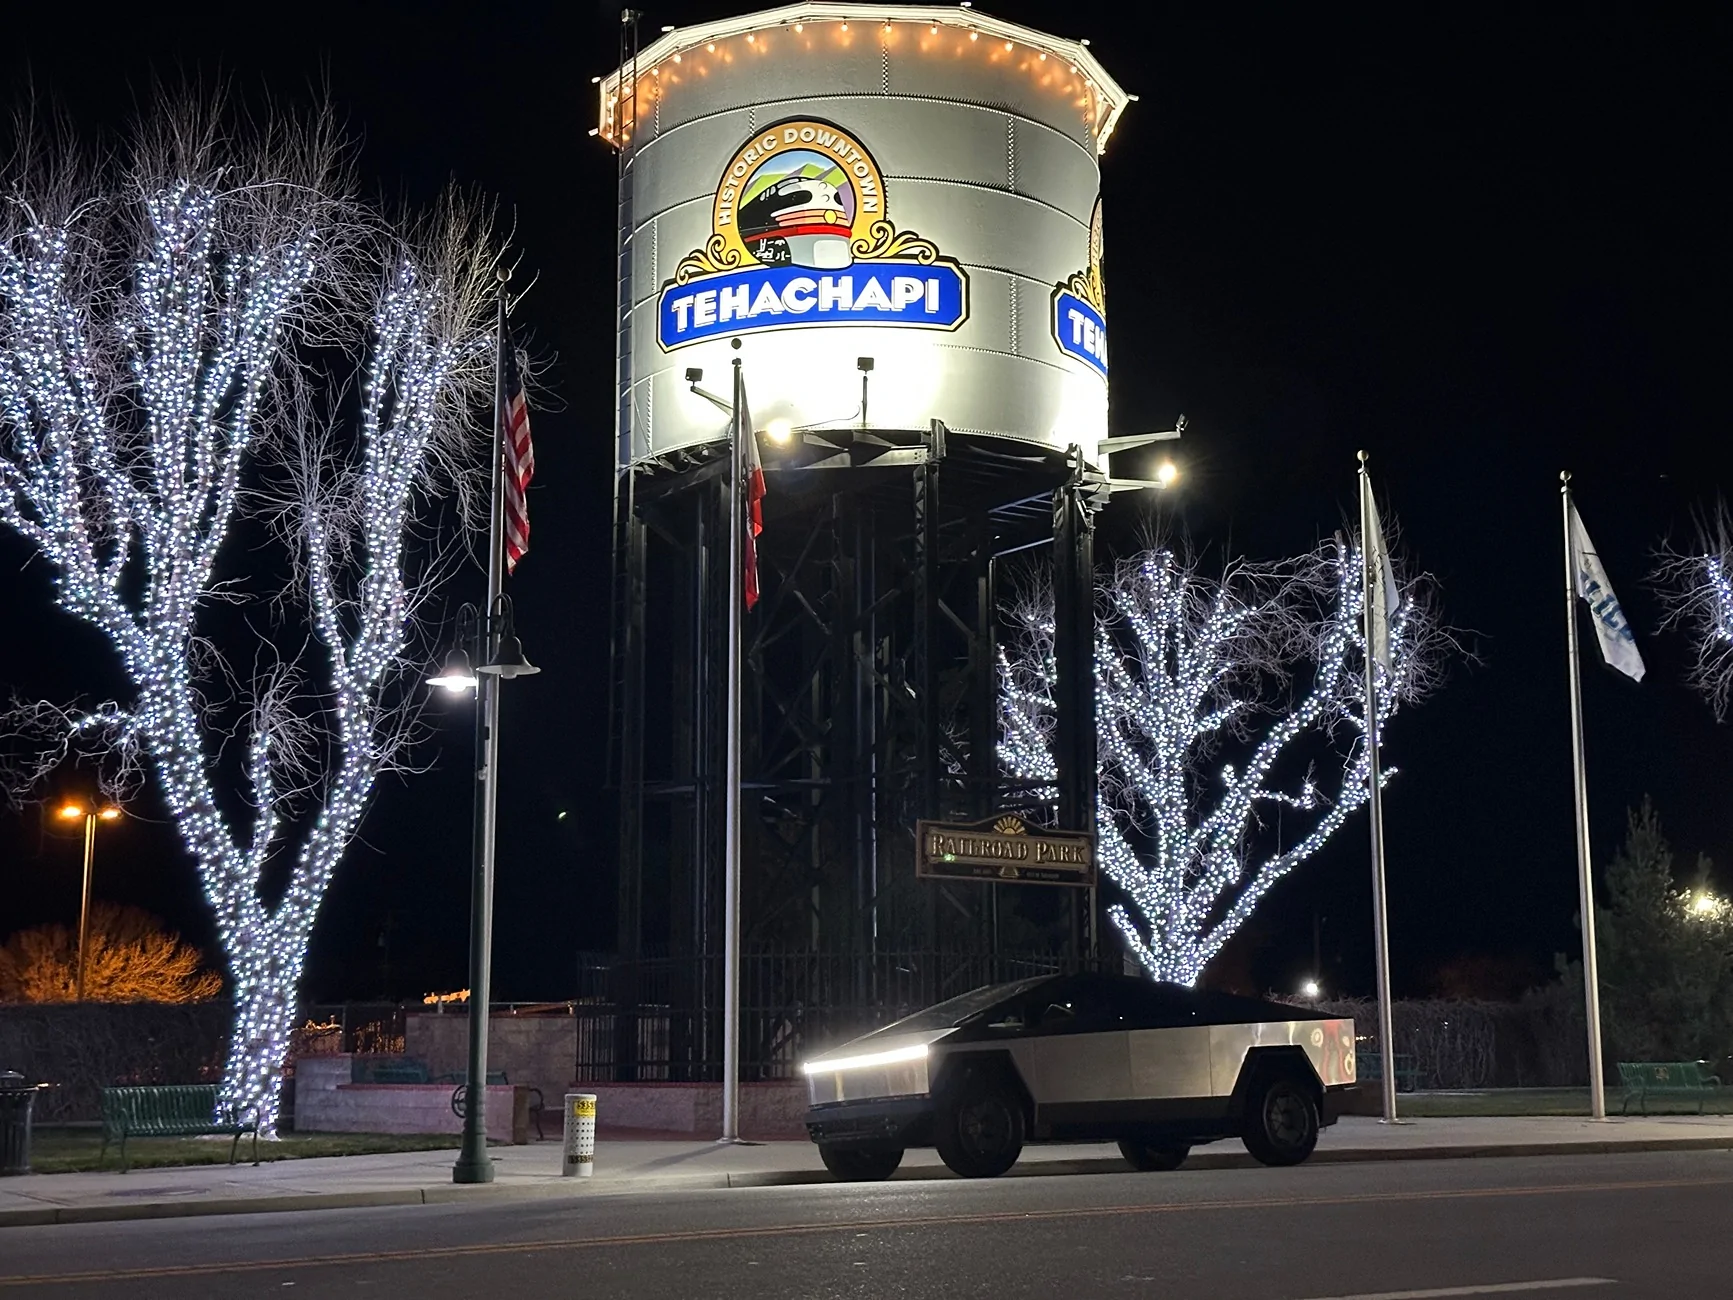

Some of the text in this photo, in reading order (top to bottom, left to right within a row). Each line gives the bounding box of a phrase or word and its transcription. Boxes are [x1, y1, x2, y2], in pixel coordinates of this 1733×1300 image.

[718, 127, 878, 226] HISTORIC DOWNTOWN
[671, 276, 939, 333] TEHACHAPI
[932, 834, 1085, 863] RAILROAD PARK
